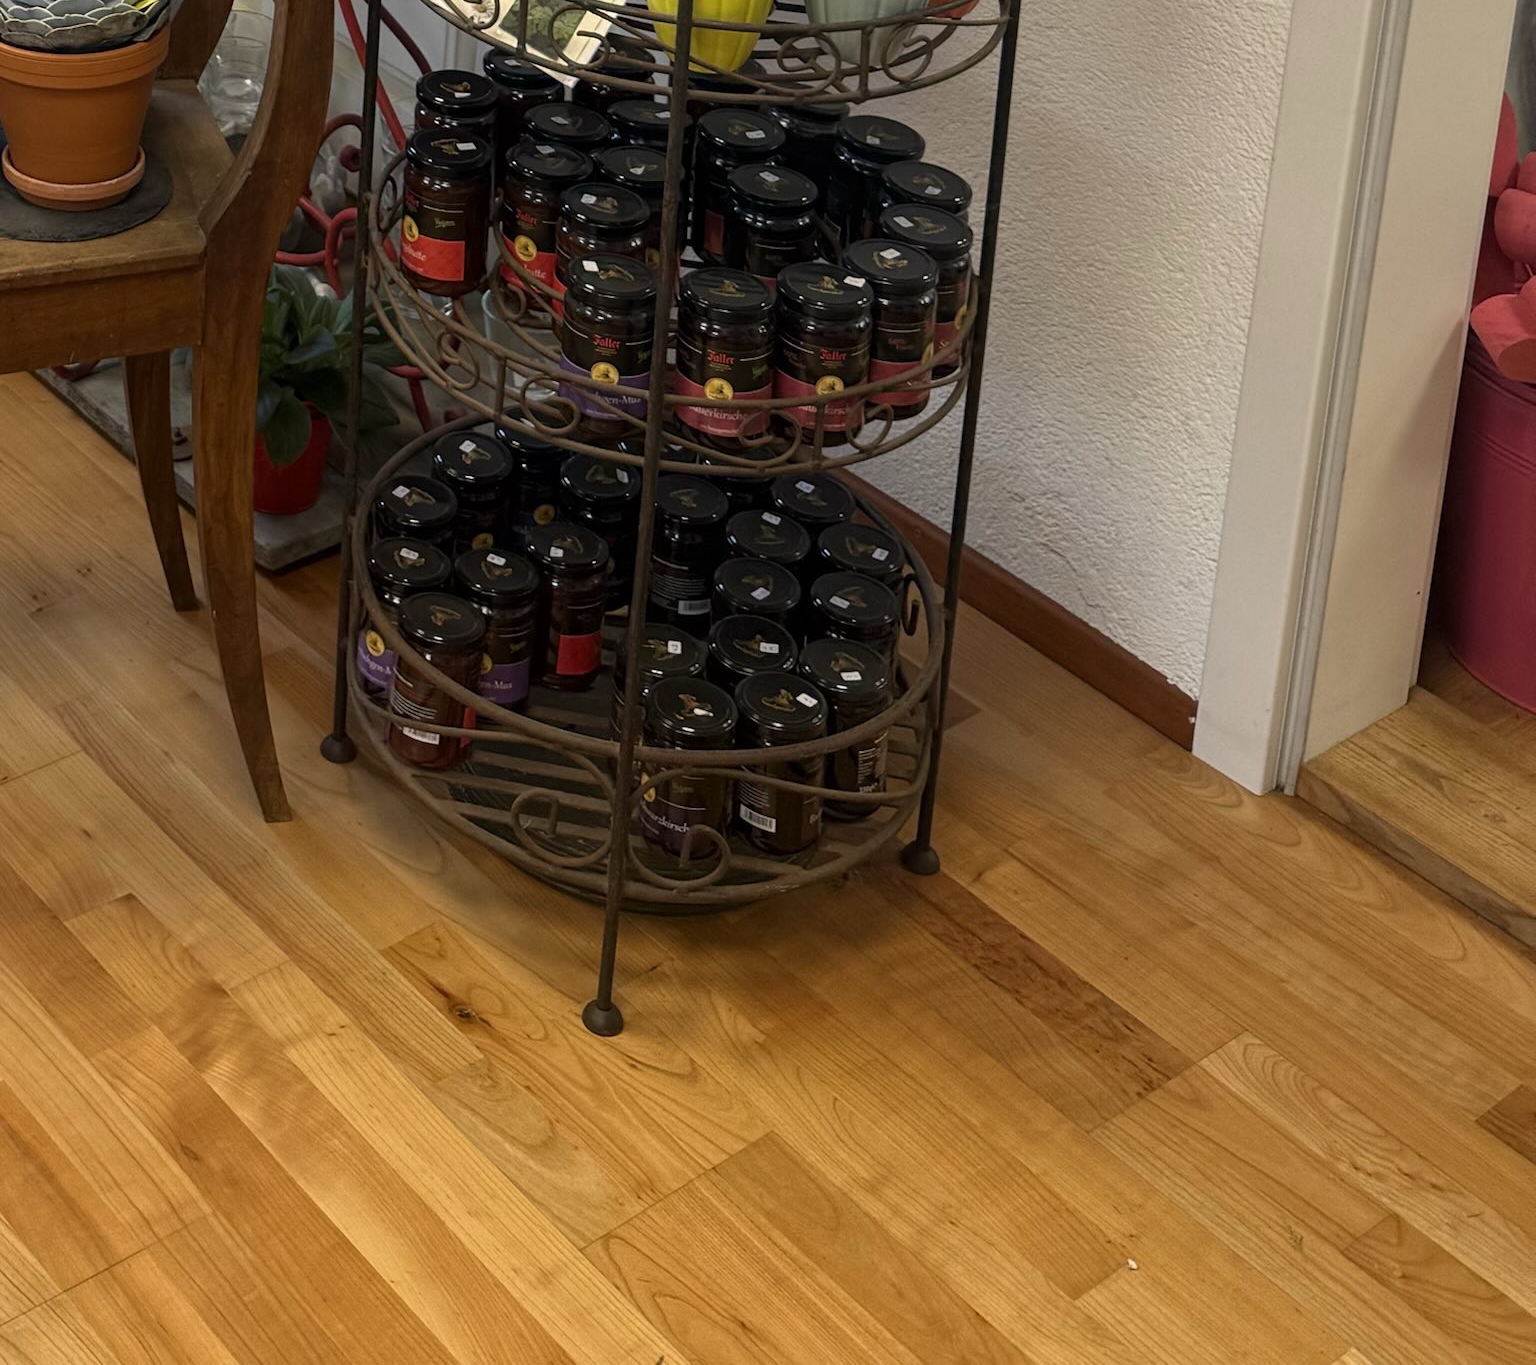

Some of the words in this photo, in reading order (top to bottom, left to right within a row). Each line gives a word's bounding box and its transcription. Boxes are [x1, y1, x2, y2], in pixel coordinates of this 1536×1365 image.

[593, 334, 622, 349] Faller
[707, 348, 735, 364] Faller
[819, 349, 847, 361] Faller
